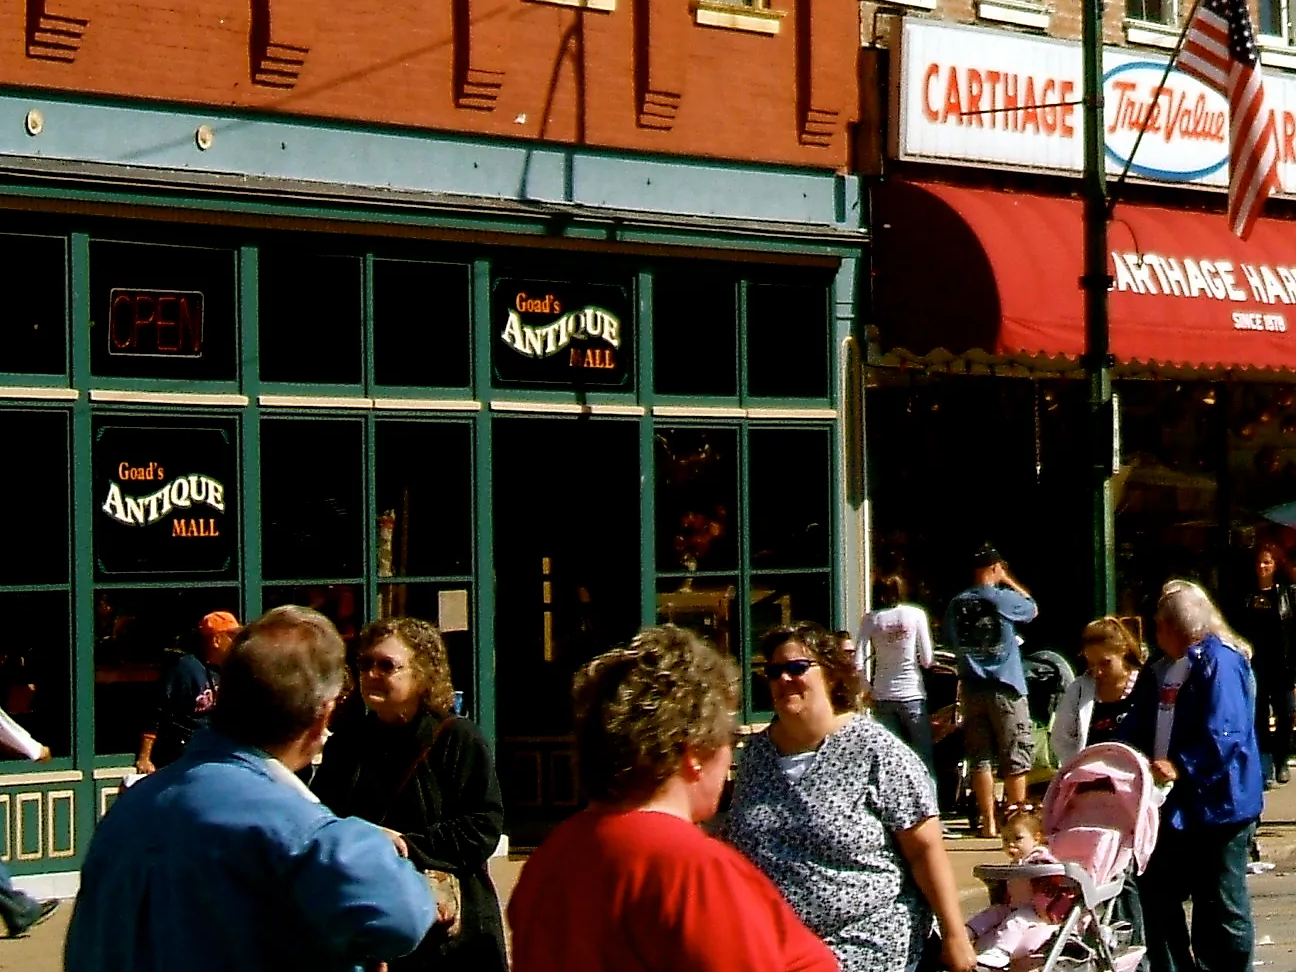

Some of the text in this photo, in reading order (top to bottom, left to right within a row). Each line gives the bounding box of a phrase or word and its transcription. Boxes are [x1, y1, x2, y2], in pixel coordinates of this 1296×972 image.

[922, 62, 1075, 138] CARTHAGE
[1107, 81, 1226, 144] True Value
[1107, 251, 1247, 301] ARTHAGE
[113, 295, 200, 352] OPEN
[514, 292, 560, 314] Goad's
[1232, 312, 1264, 331] SINCE
[501, 307, 620, 358] ANTIQUE
[118, 461, 164, 481] Goad's
[102, 474, 226, 527] ANTIQUE
[172, 518, 220, 538] MALL
